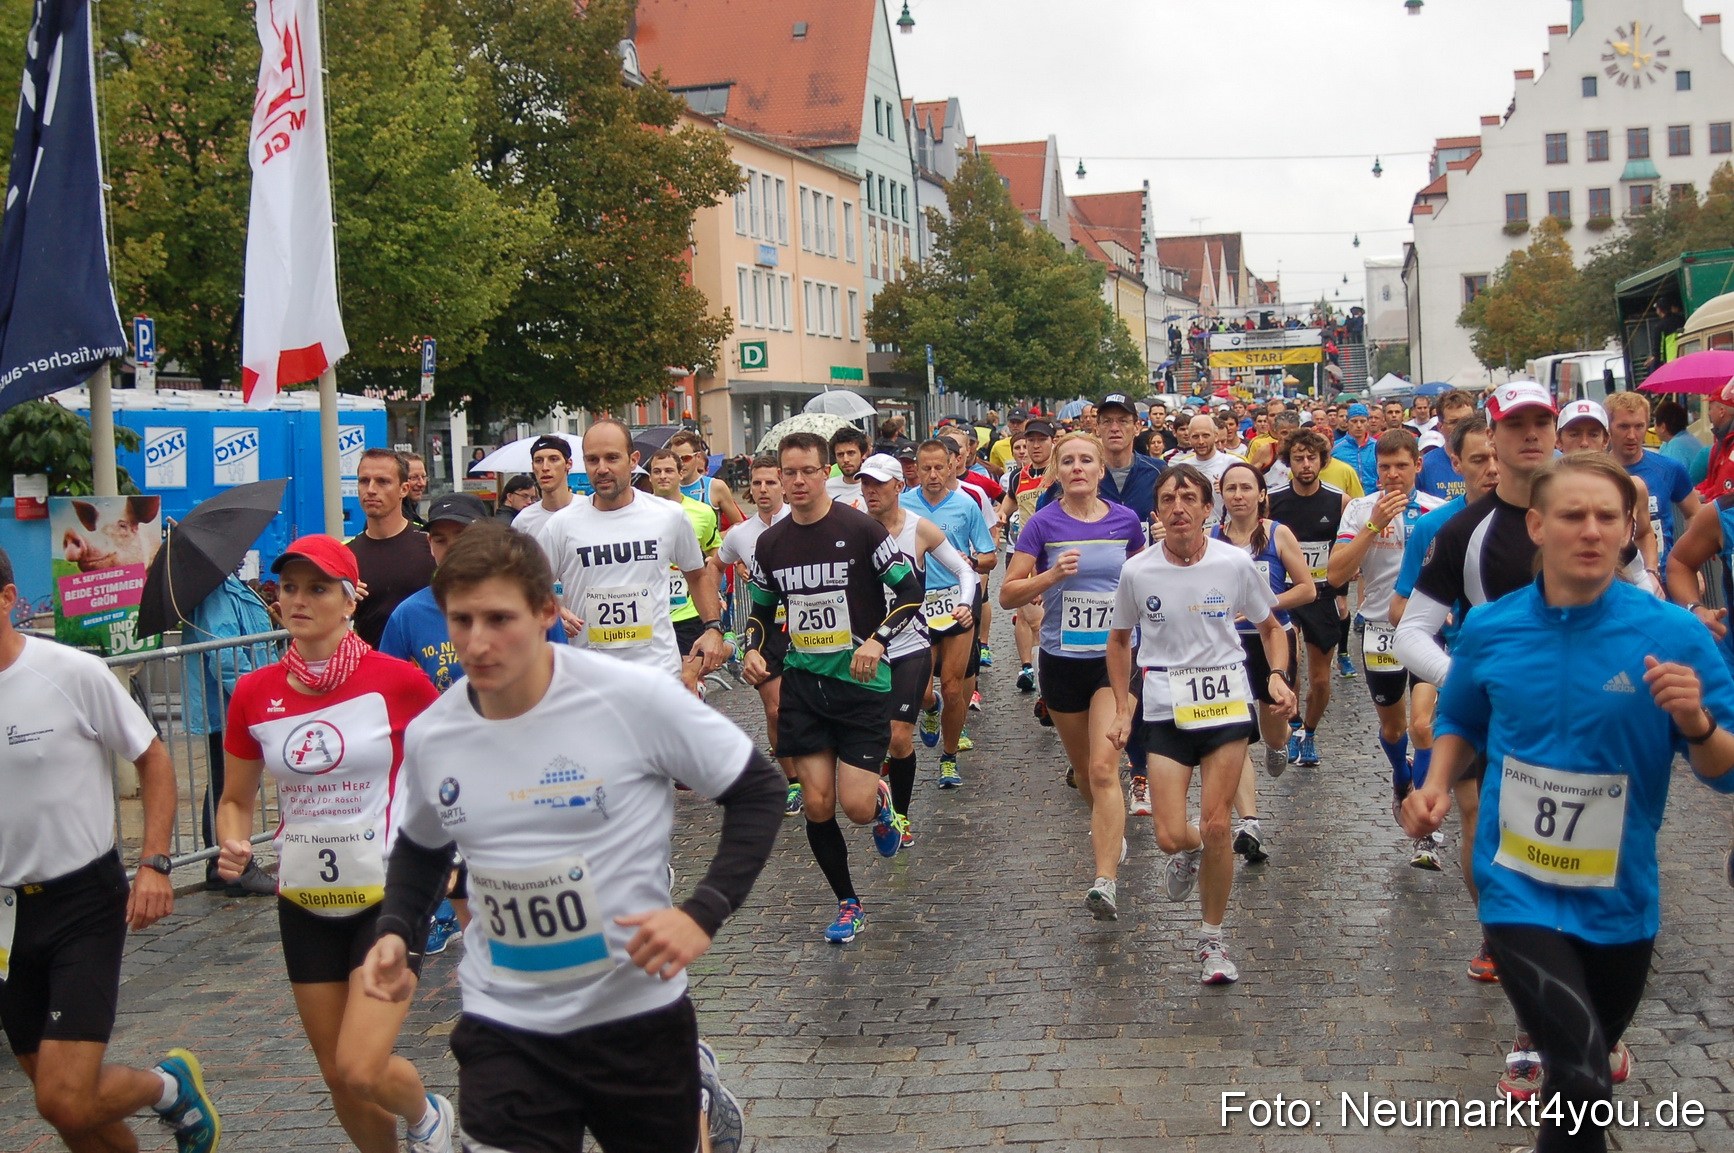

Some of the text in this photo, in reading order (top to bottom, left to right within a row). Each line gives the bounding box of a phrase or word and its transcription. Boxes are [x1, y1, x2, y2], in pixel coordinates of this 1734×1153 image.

[138, 324, 151, 357] P
[743, 345, 763, 365] D
[1246, 352, 1284, 363] START
[576, 540, 657, 568] THULE
[82, 569, 124, 583] SEPTEMBER
[772, 561, 849, 592] THULE
[64, 578, 144, 601] BEIDE STIMMEN
[586, 591, 639, 600] PARTL Neumarkt
[90, 594, 118, 608] GRÜN
[803, 598, 835, 608] Neumarkt
[925, 598, 954, 617] 536
[1063, 596, 1085, 604] PARTL
[597, 600, 638, 625] 251
[798, 606, 836, 631] 250
[109, 620, 135, 634] UND
[603, 630, 636, 642] Ljubisa
[803, 635, 834, 645] Rickard
[421, 645, 439, 658] 10.
[1169, 665, 1228, 678] PARTL Neumarkt
[1186, 674, 1231, 702] 164
[1602, 683, 1636, 694] adidas
[1193, 705, 1229, 719] Herbert
[280, 780, 371, 793] LAUFEN MIT HERZ
[1504, 768, 1603, 797] PARTL Neumarkt
[1533, 796, 1586, 843] 87
[284, 833, 360, 844] PARTL Neumarkt
[1527, 844, 1580, 870] Steven
[318, 848, 340, 883] 3
[502, 875, 564, 891] Neumarkt
[299, 891, 366, 907] Stephanie
[484, 889, 588, 939] 3160
